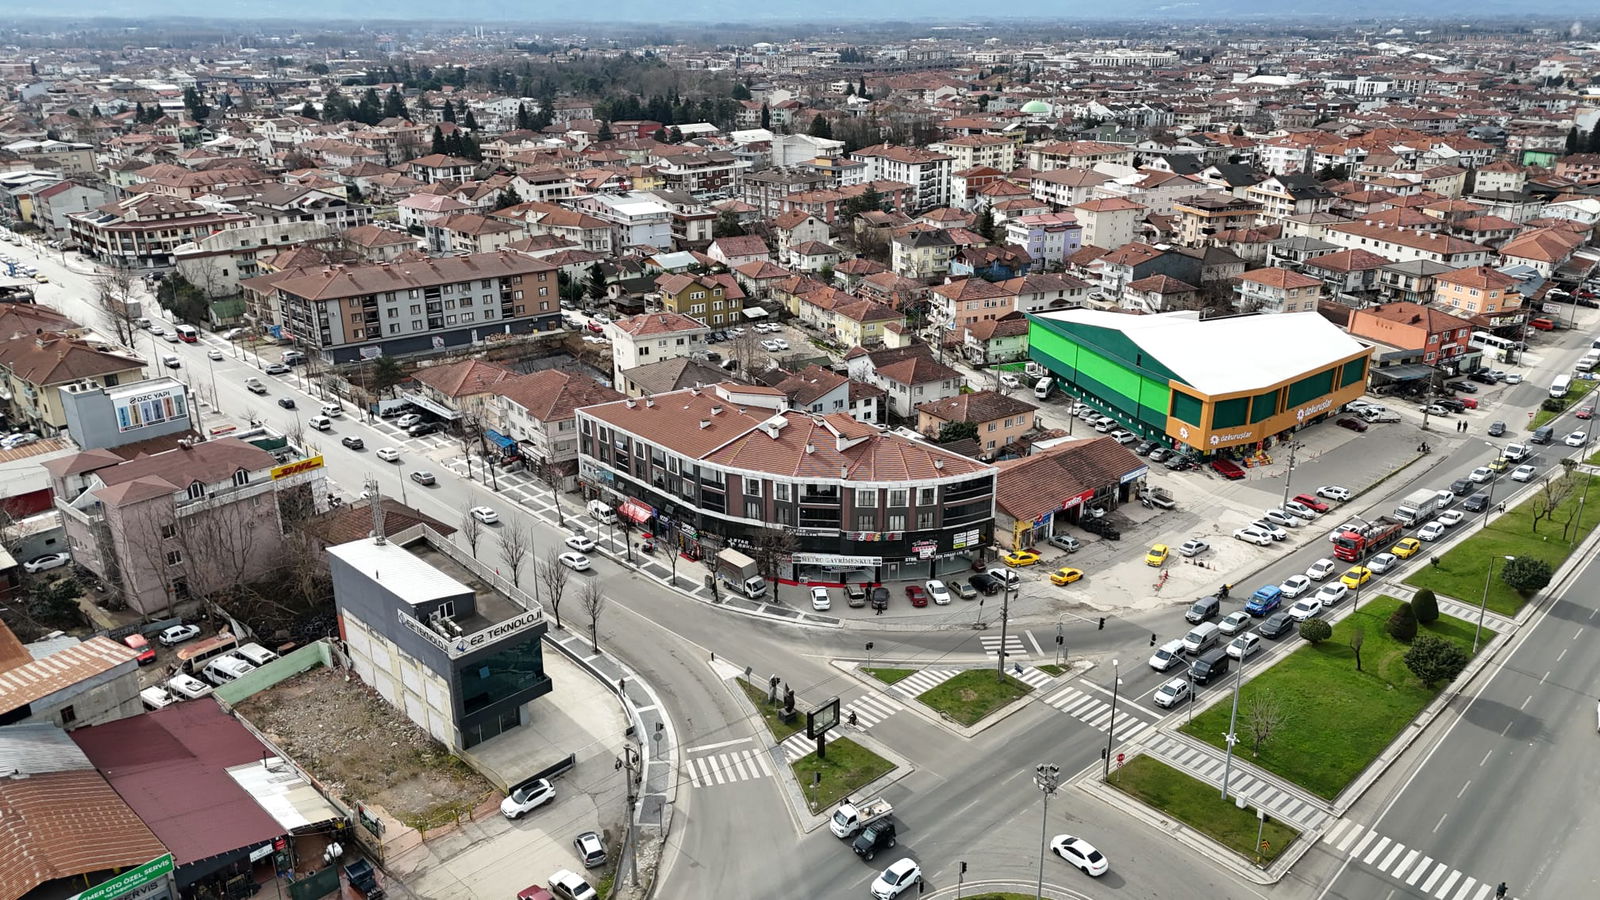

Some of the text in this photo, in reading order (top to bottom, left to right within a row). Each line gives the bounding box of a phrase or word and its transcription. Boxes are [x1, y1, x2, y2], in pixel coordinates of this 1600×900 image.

[137, 390, 171, 403] DZC YAPI
[278, 461, 316, 476] DHL
[105, 881, 121, 893] OTO
[123, 872, 143, 884] ÖZEL
[143, 859, 170, 875] SERVİS
